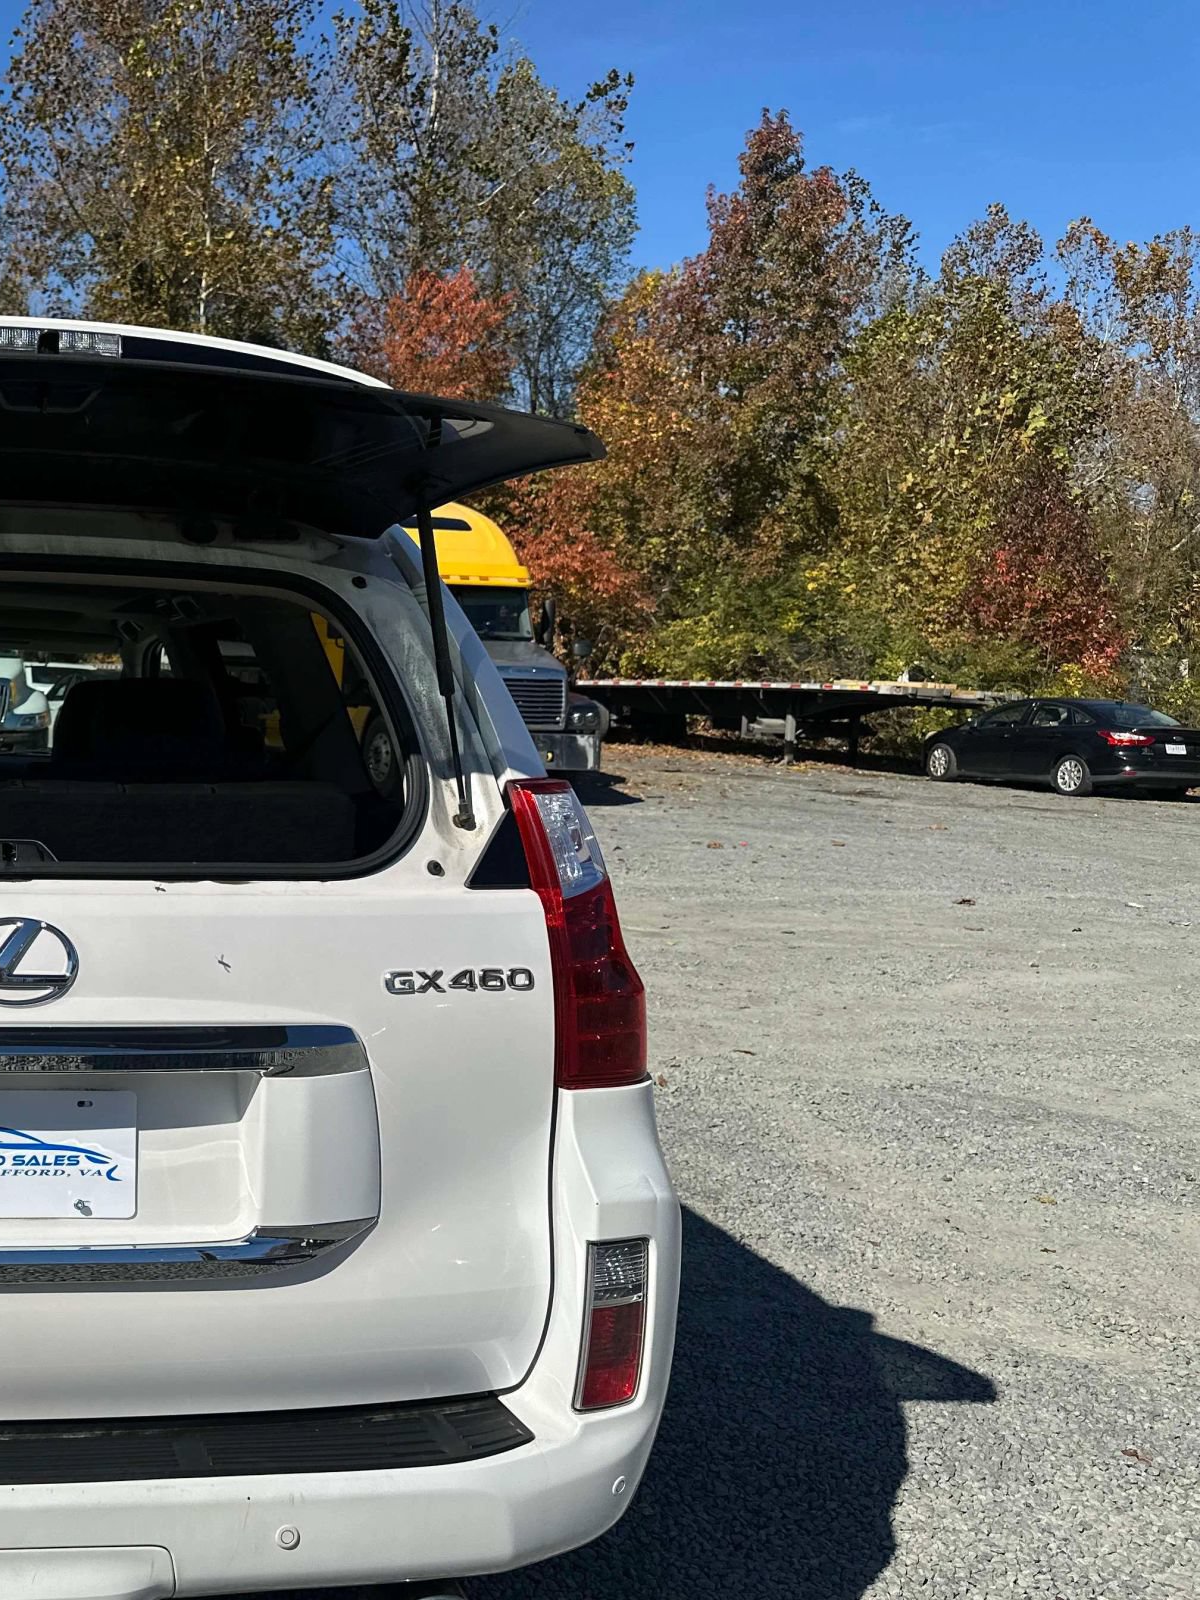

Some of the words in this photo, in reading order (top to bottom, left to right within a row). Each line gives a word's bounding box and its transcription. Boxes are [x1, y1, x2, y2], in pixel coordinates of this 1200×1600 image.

[385, 967, 535, 995] GX460
[12, 1155, 80, 1167] SALES
[80, 1169, 103, 1177] VA
